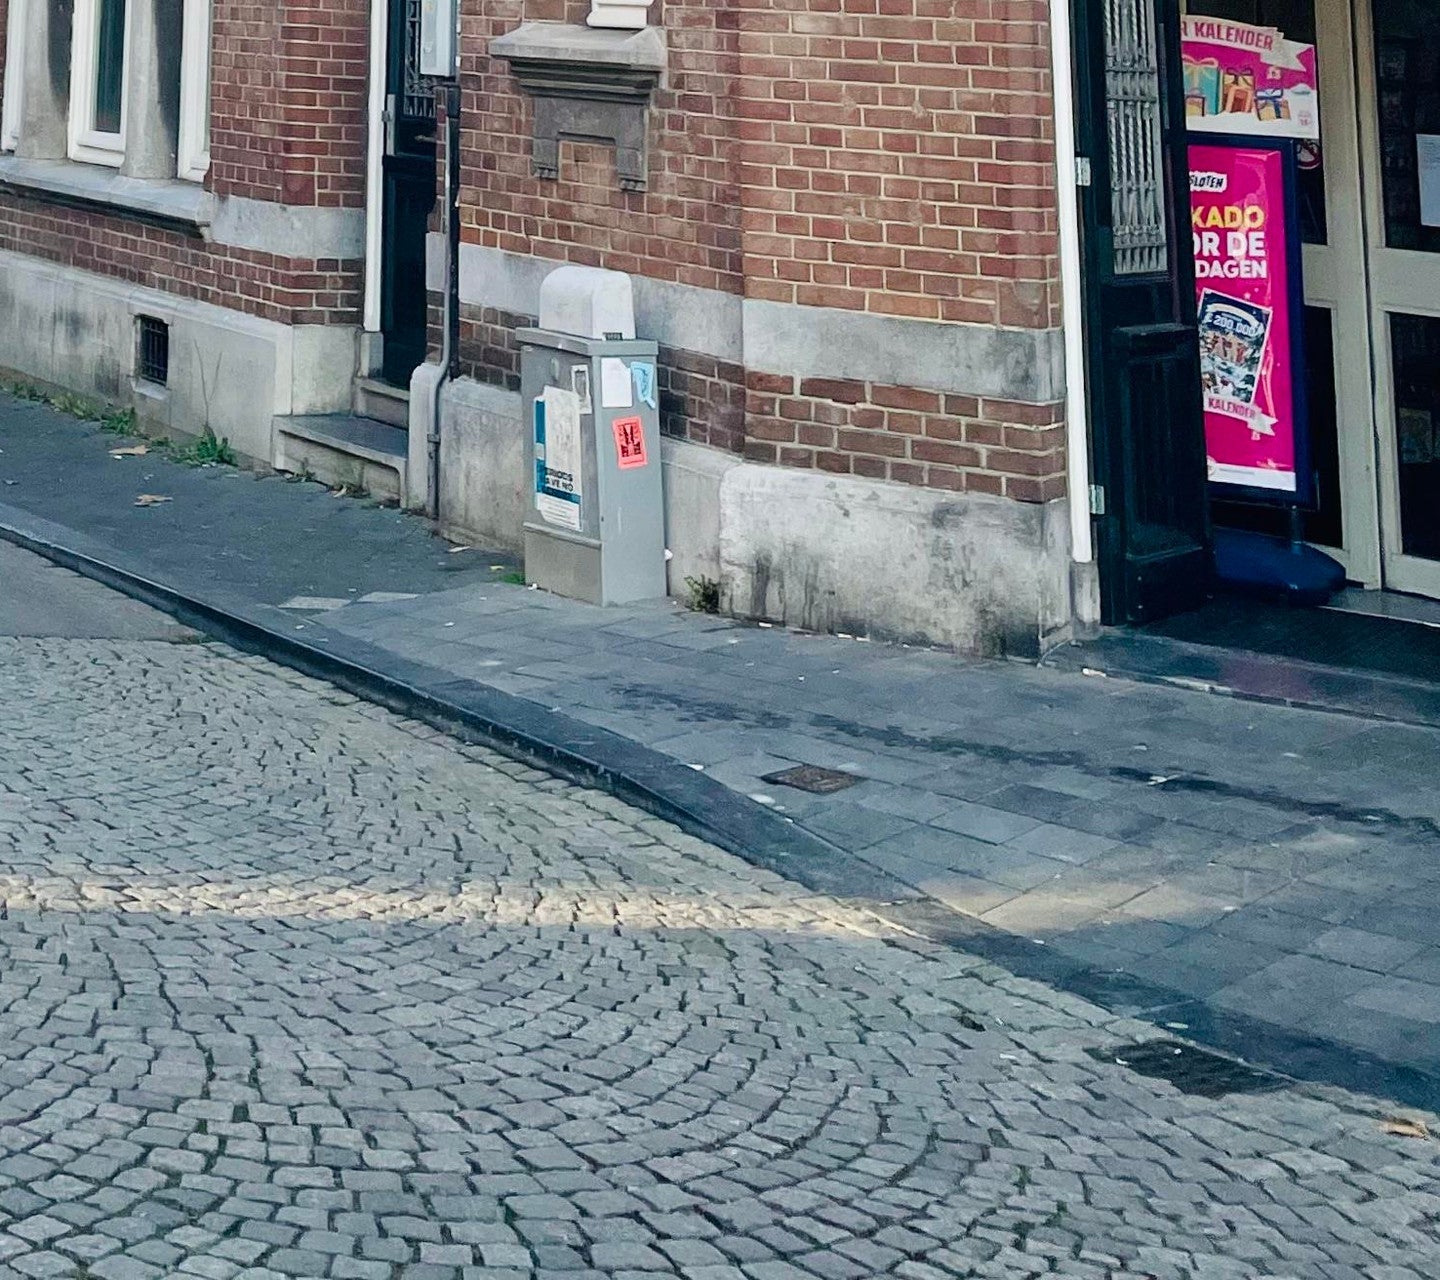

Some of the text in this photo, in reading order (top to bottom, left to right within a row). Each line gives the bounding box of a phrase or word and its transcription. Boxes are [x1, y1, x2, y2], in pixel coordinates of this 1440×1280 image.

[1194, 21, 1273, 50] KALENDER
[1191, 205, 1265, 228] KADO
[1227, 231, 1266, 257] DE
[1195, 259, 1268, 278] DAGEN
[1208, 397, 1256, 419] KALENDER
